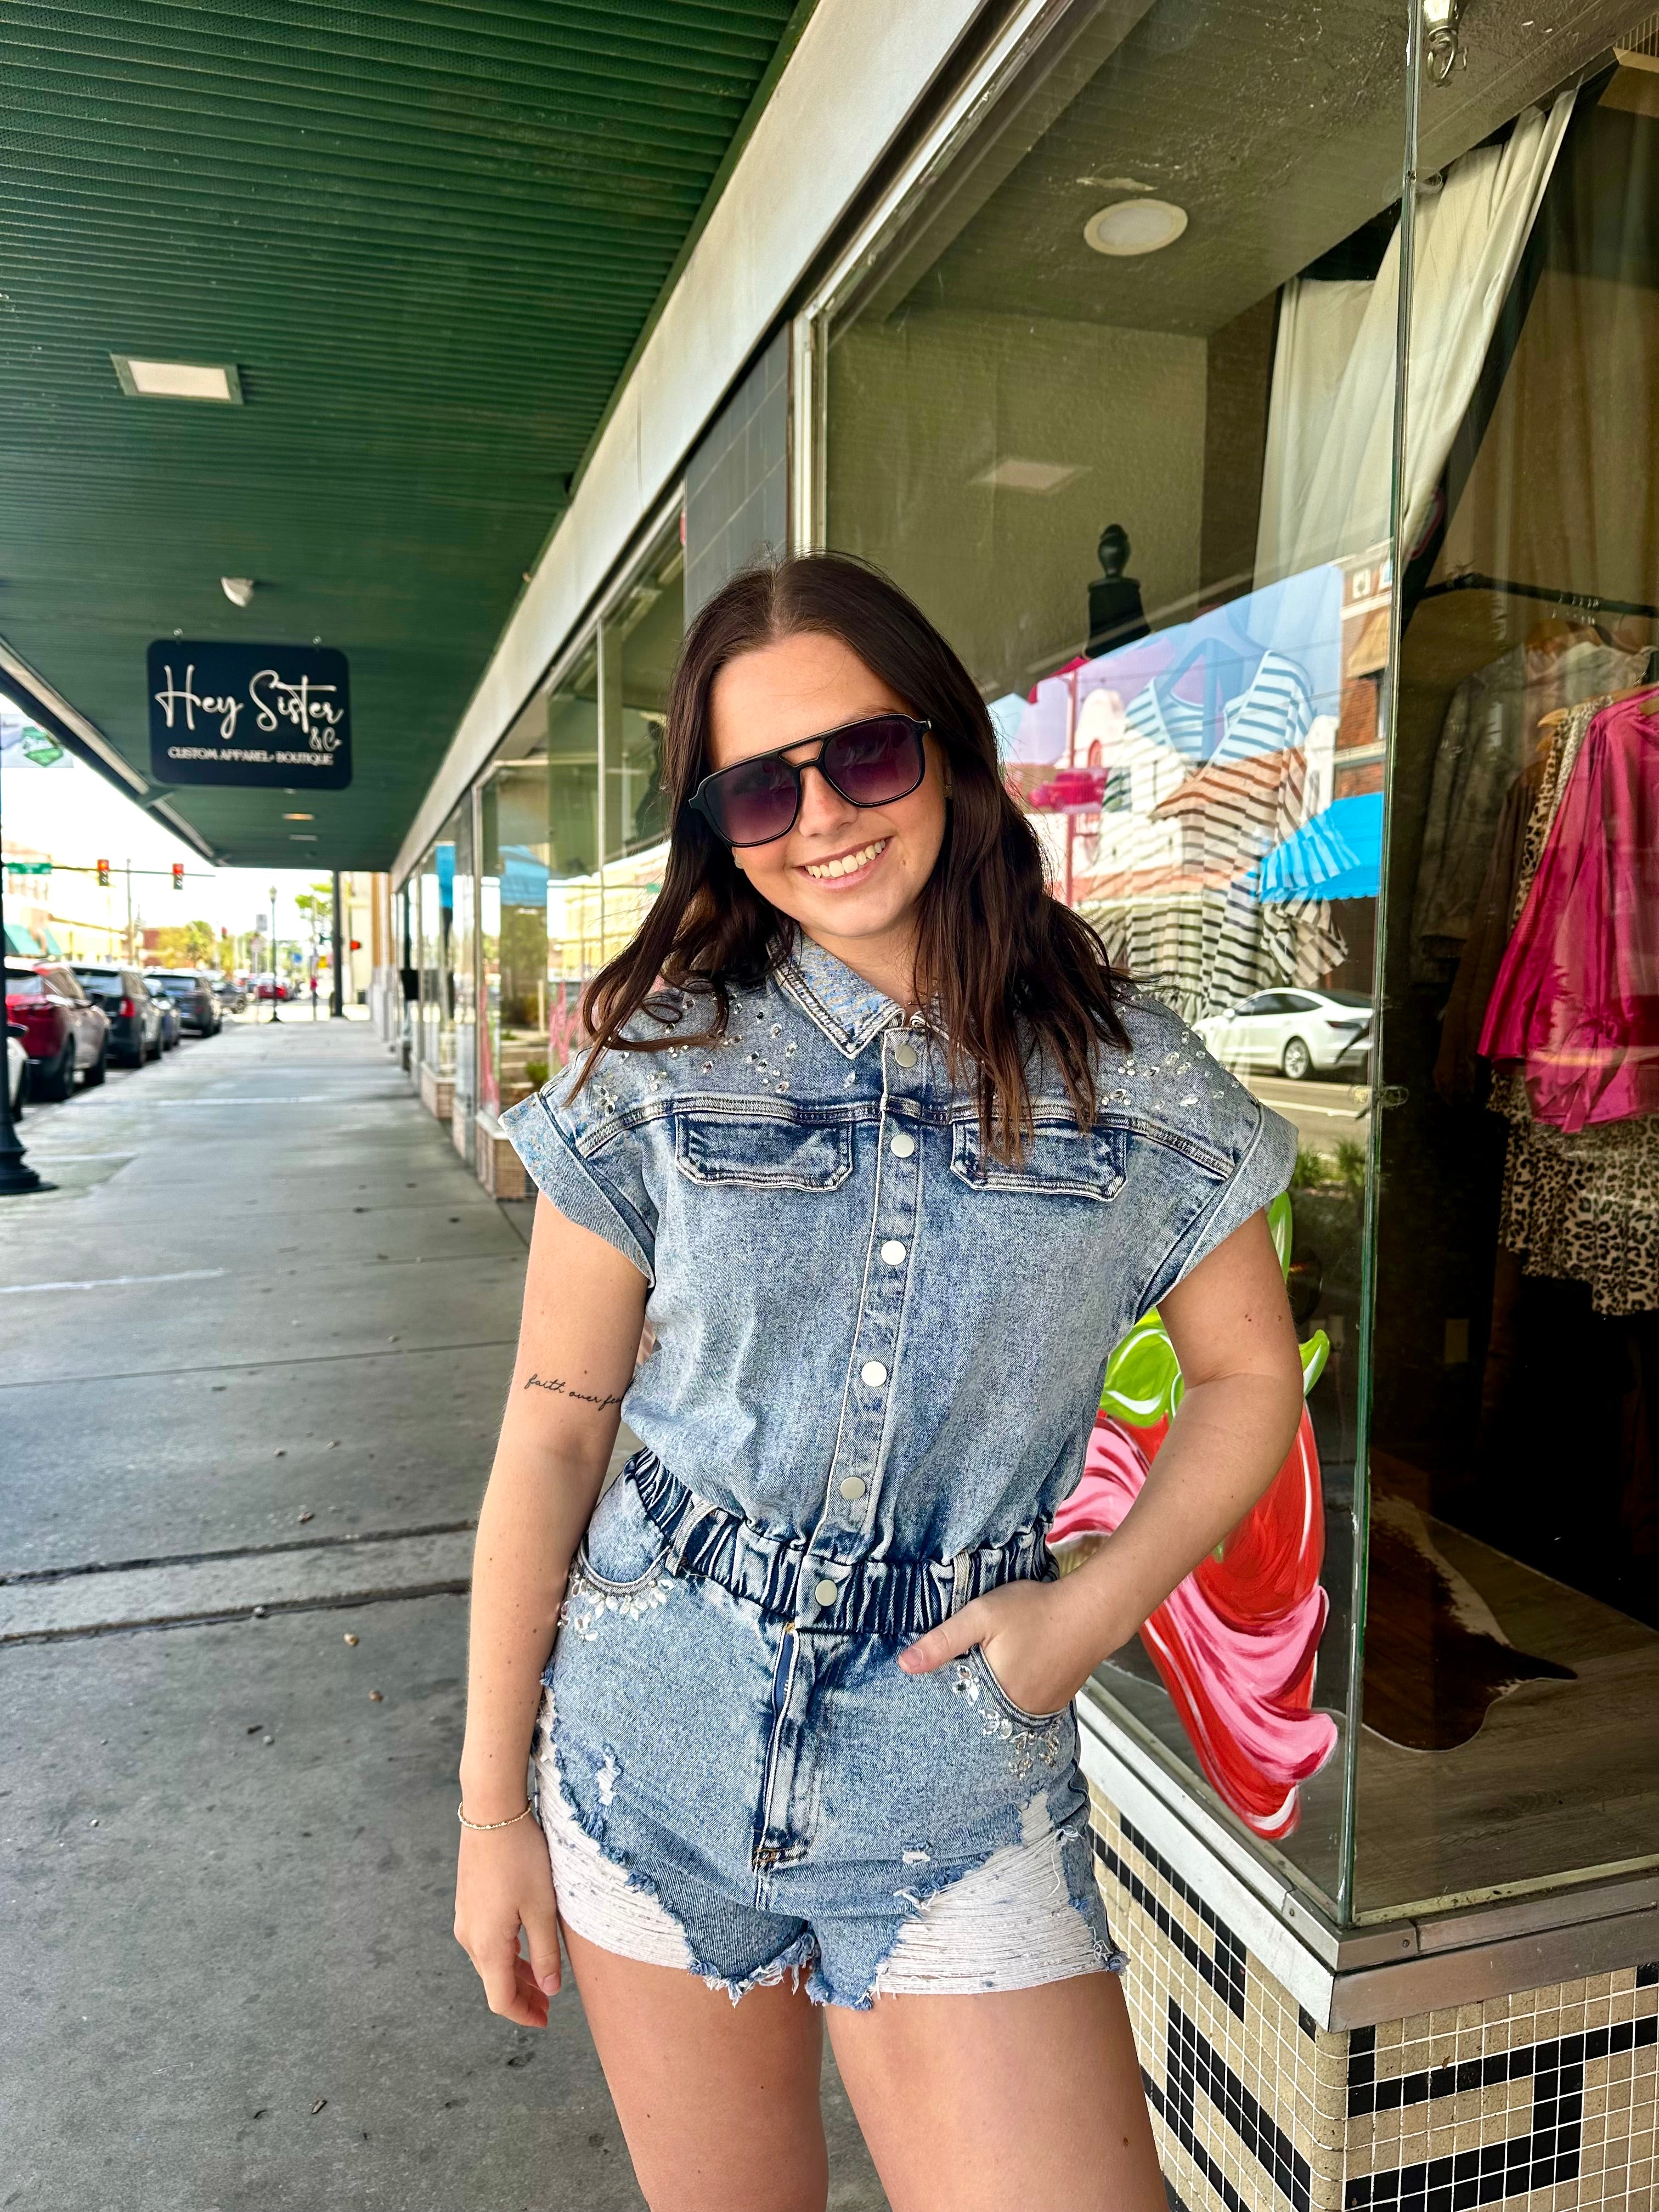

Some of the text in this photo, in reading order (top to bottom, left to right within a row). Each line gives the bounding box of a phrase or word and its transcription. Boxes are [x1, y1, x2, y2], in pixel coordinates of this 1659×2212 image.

[155, 664, 344, 740] Hey Sister
[167, 746, 334, 766] CUSTOM APPAREL BOUTIQUE
[524, 1373, 566, 1393] faith
[569, 1390, 602, 1403] over
